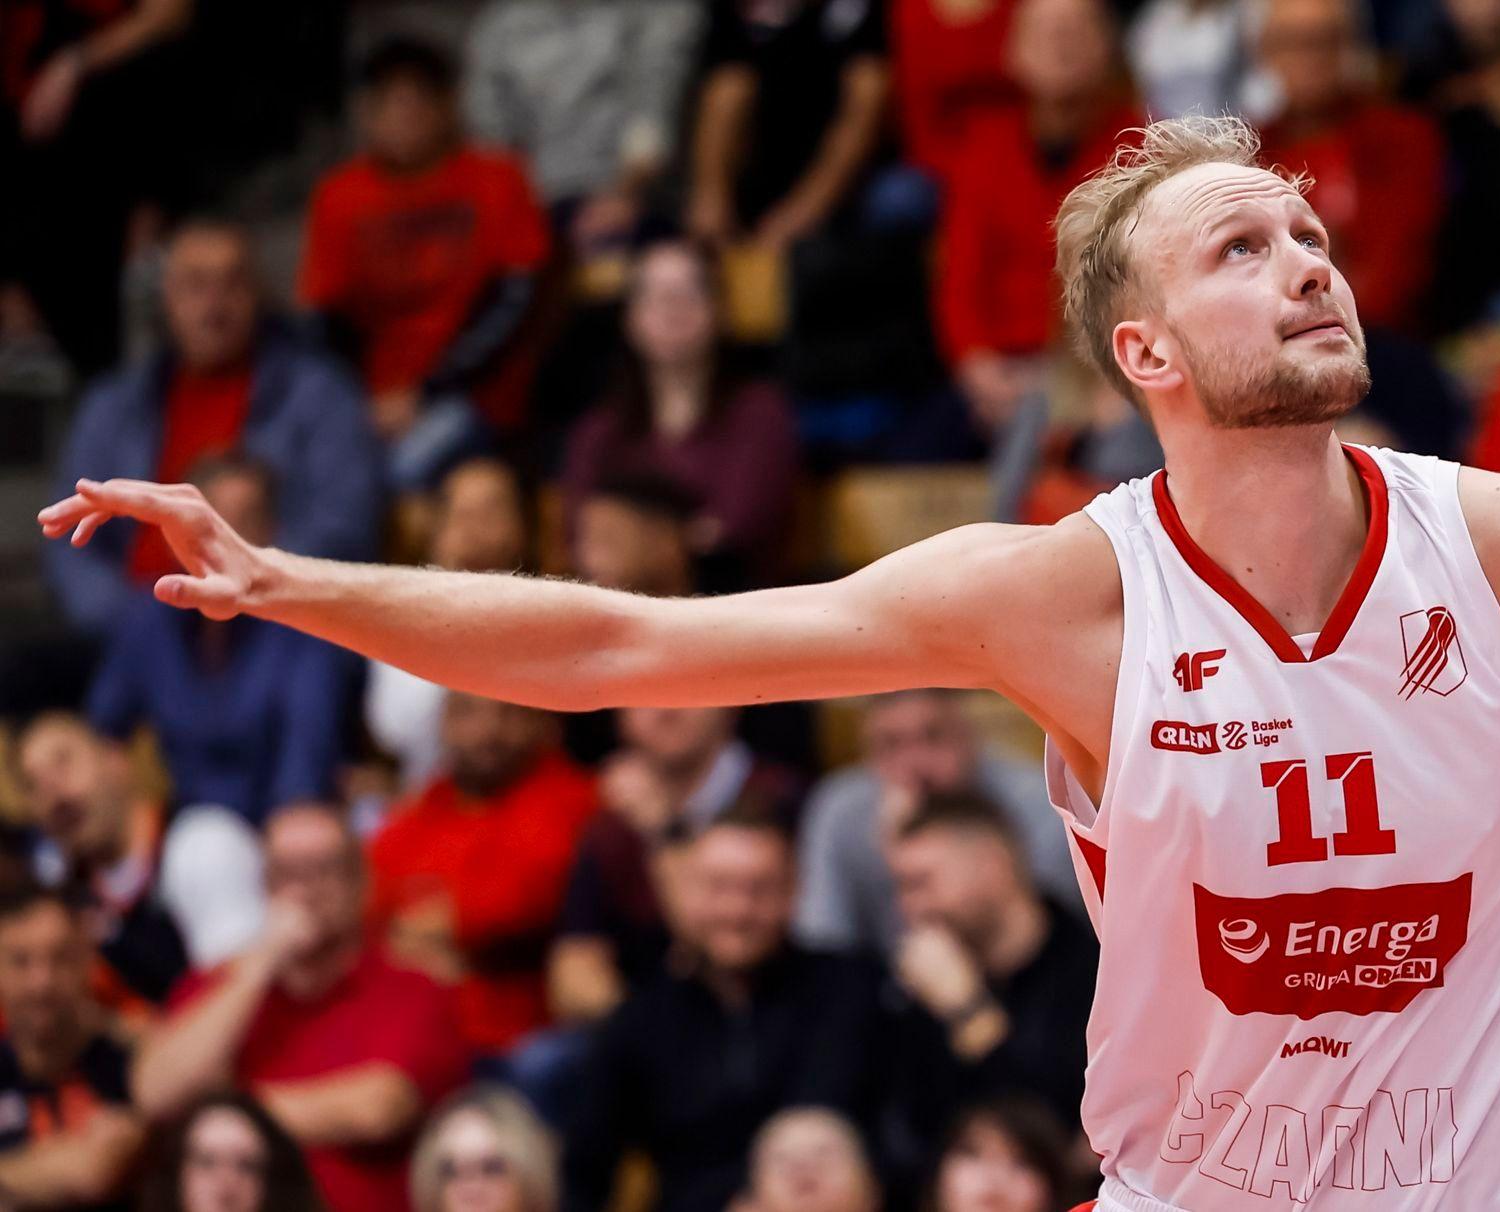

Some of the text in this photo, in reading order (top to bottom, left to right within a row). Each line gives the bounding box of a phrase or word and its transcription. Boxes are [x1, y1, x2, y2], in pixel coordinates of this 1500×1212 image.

[1158, 726, 1212, 748] ORLEN
[1252, 719, 1293, 731] Basket
[1253, 733, 1279, 746] Liga
[1260, 751, 1396, 867] 11
[1285, 914, 1439, 960] Energa
[1284, 961, 1431, 990] GRUPA ORLEN
